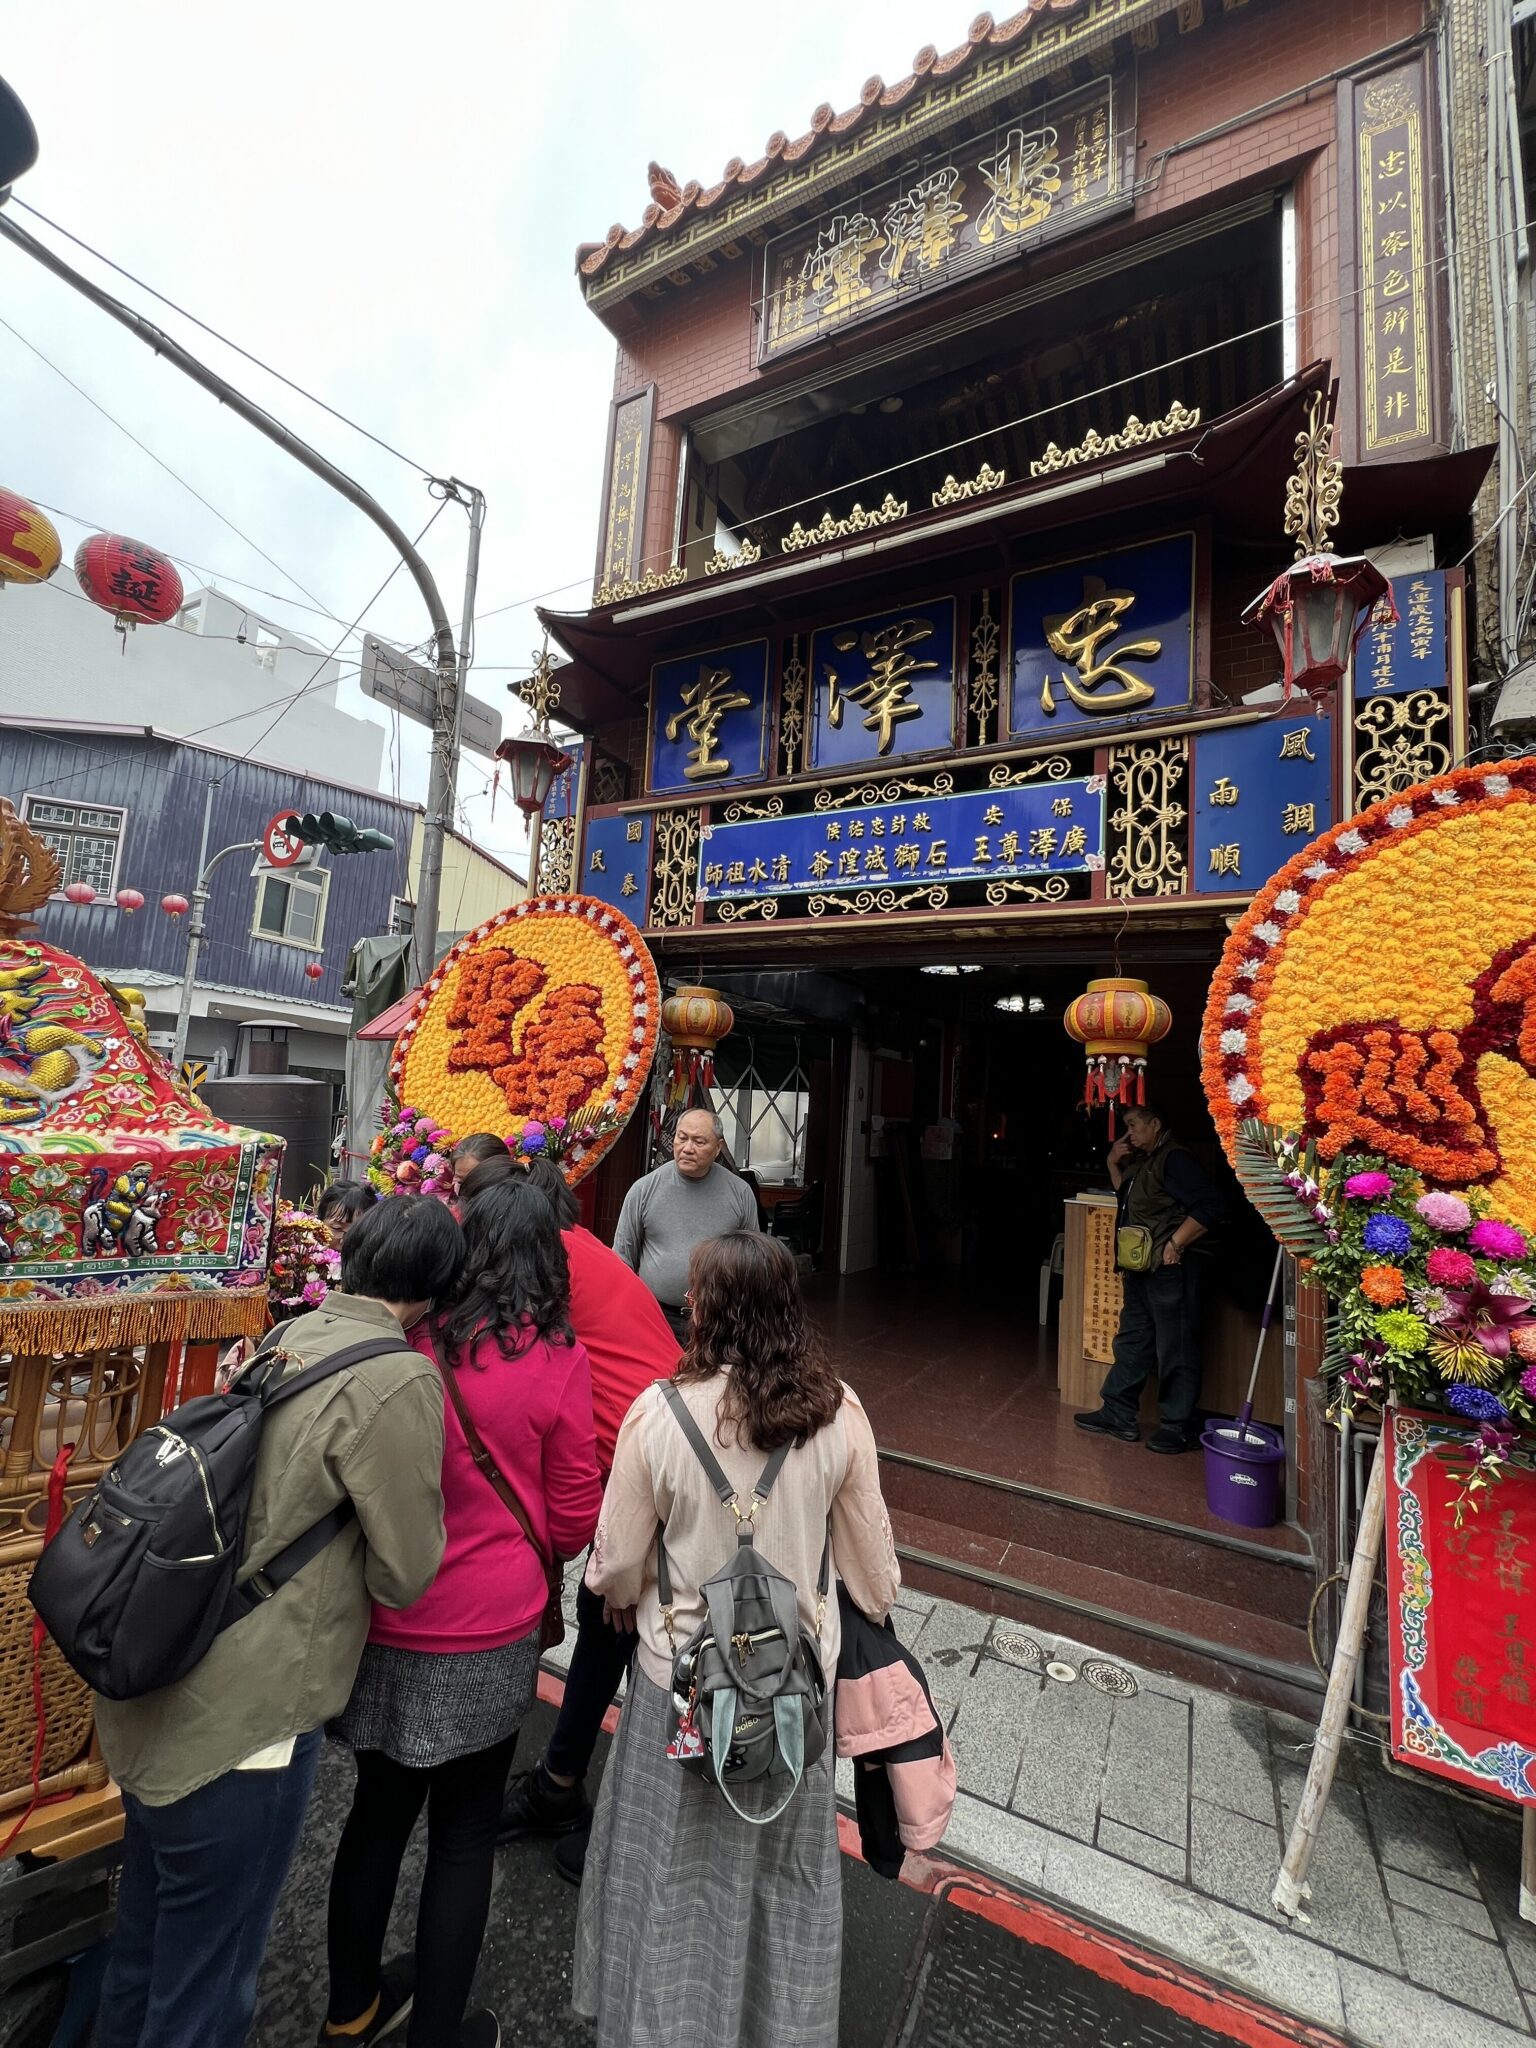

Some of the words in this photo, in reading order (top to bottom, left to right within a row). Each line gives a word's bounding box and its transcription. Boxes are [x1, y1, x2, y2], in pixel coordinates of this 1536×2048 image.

[1377, 149, 1411, 420] 忠以察色辨是非
[664, 575, 1163, 778] 忠澤堂
[808, 840, 947, 880] 石獅城隍爺
[972, 825, 1087, 864] 廣澤尊王
[704, 854, 792, 888] 清水祖師
